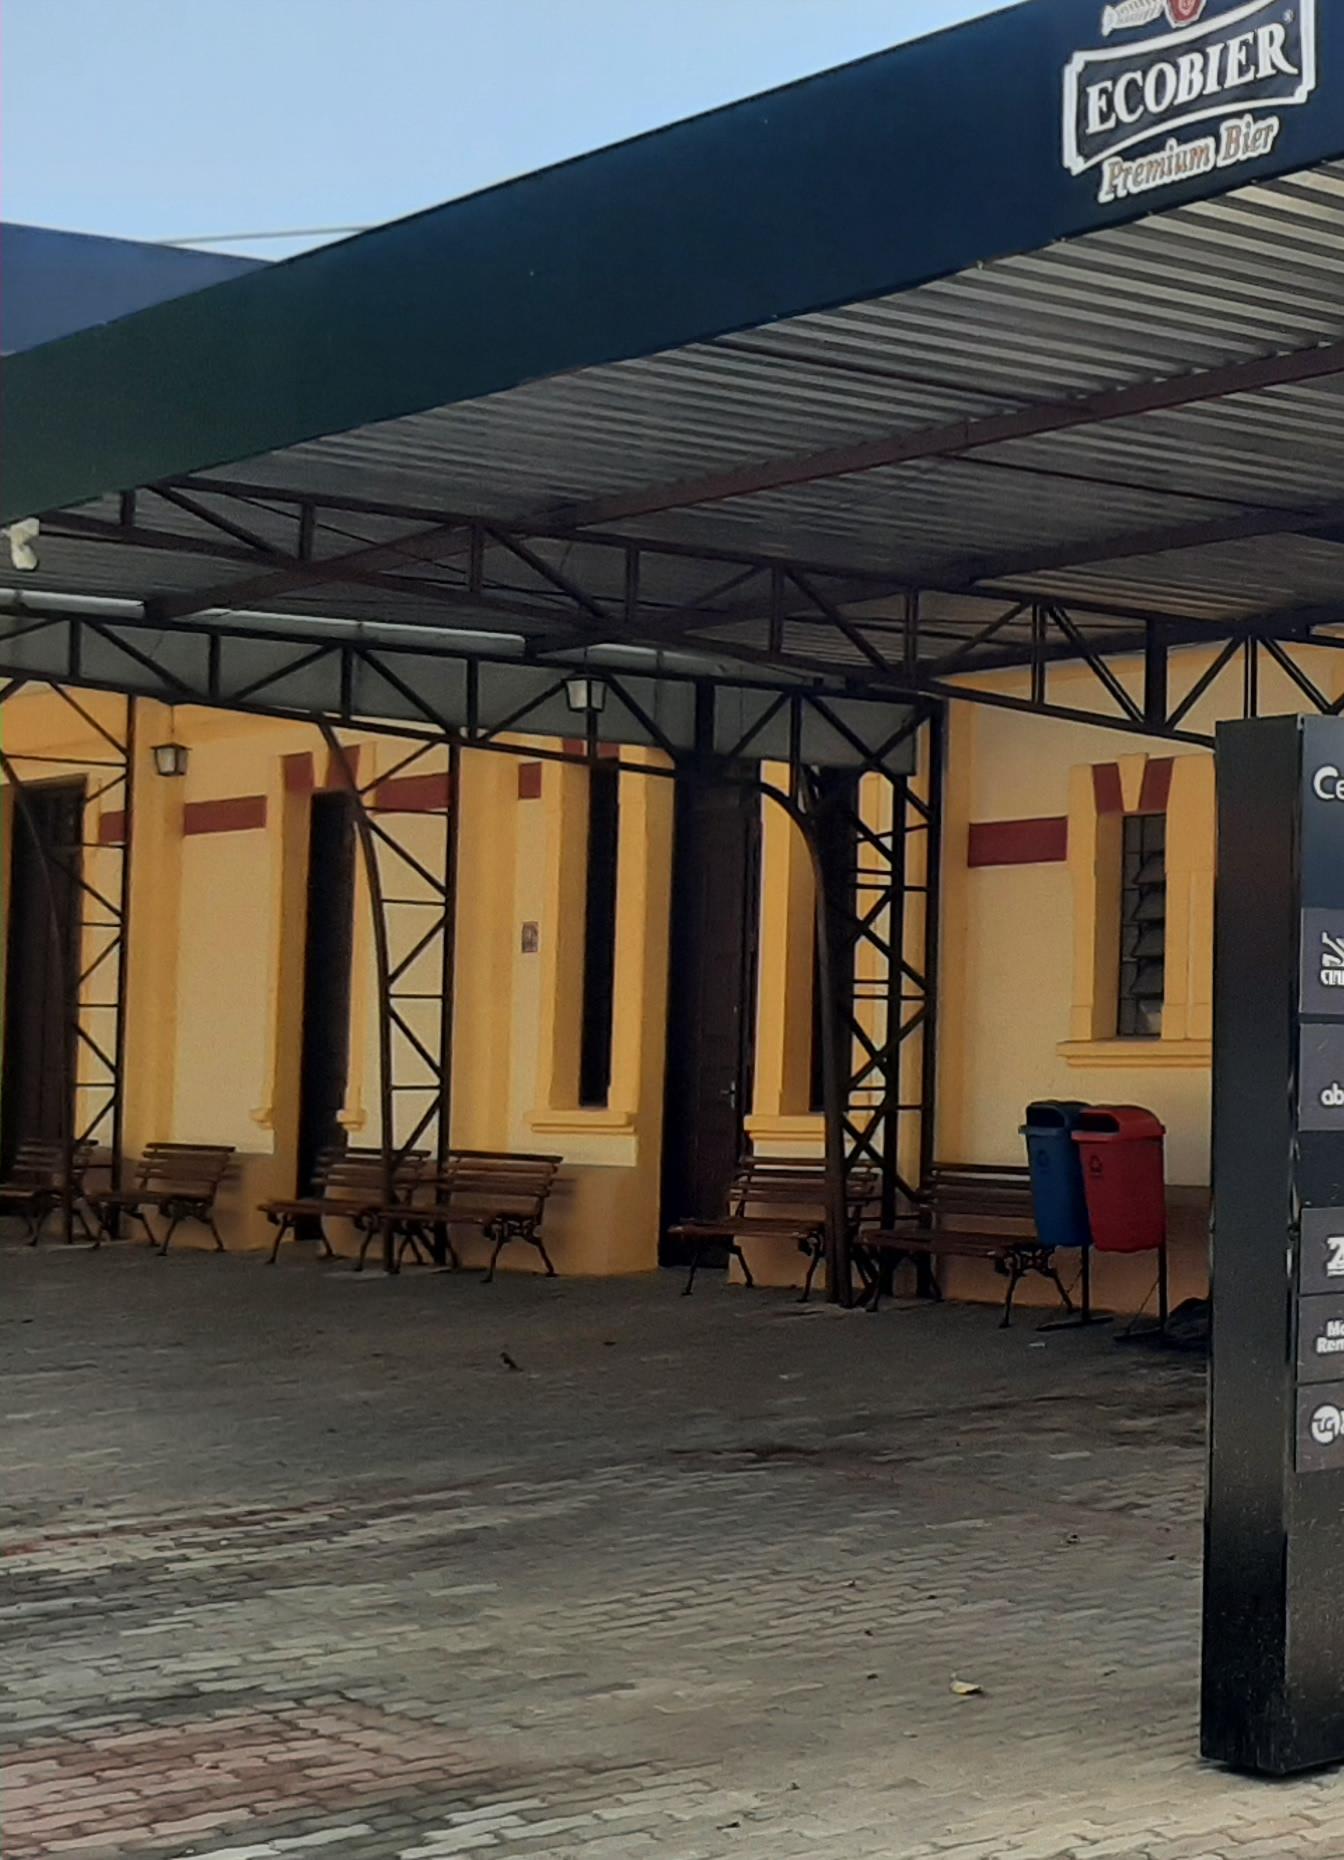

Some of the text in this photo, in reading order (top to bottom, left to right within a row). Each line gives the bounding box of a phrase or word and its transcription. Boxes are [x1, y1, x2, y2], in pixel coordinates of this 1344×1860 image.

[1085, 22, 1299, 135] ECOBIER
[1098, 114, 1280, 203] Premium Bier
